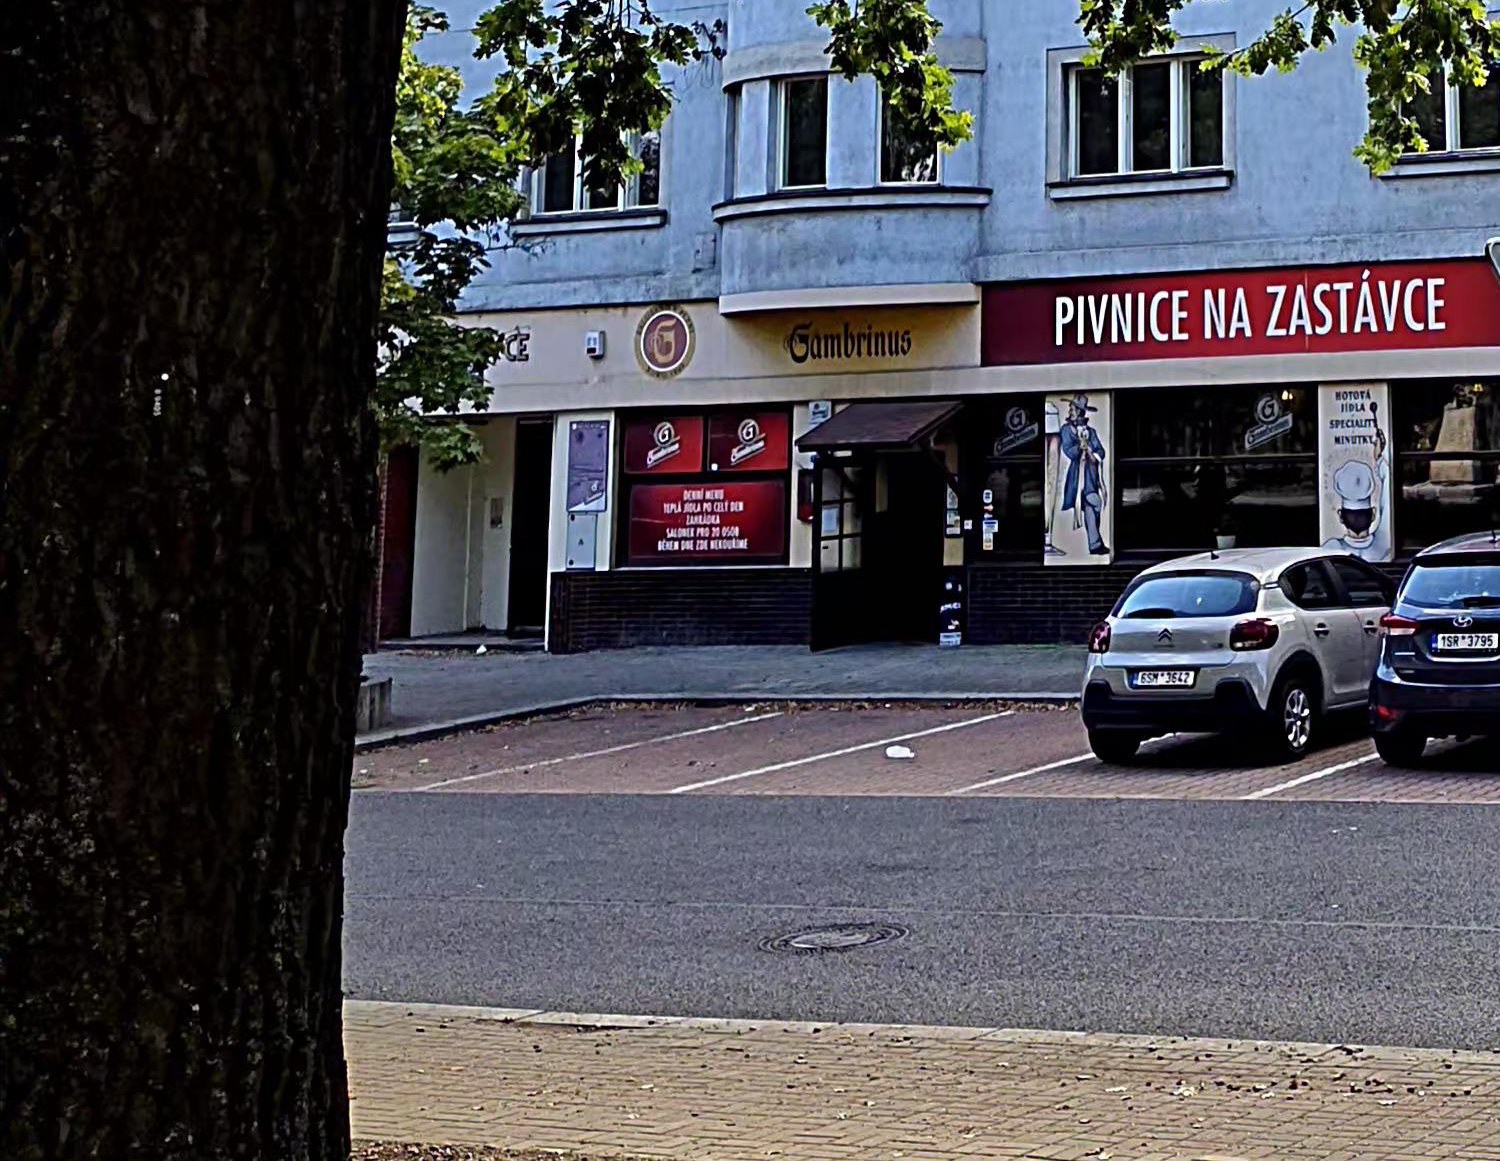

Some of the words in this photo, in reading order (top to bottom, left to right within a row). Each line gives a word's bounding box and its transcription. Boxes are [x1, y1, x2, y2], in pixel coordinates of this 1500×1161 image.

[1055, 290, 1190, 346] PIVNICE
[1204, 287, 1252, 340] NA
[1265, 269, 1447, 337] ZASTÁVCE
[786, 321, 912, 364] Gambrinus
[1334, 389, 1371, 402] HOTOVÁ
[1340, 402, 1366, 413] JÍDLA
[1441, 636, 1460, 647] 1SR
[1467, 635, 1494, 647] 3795
